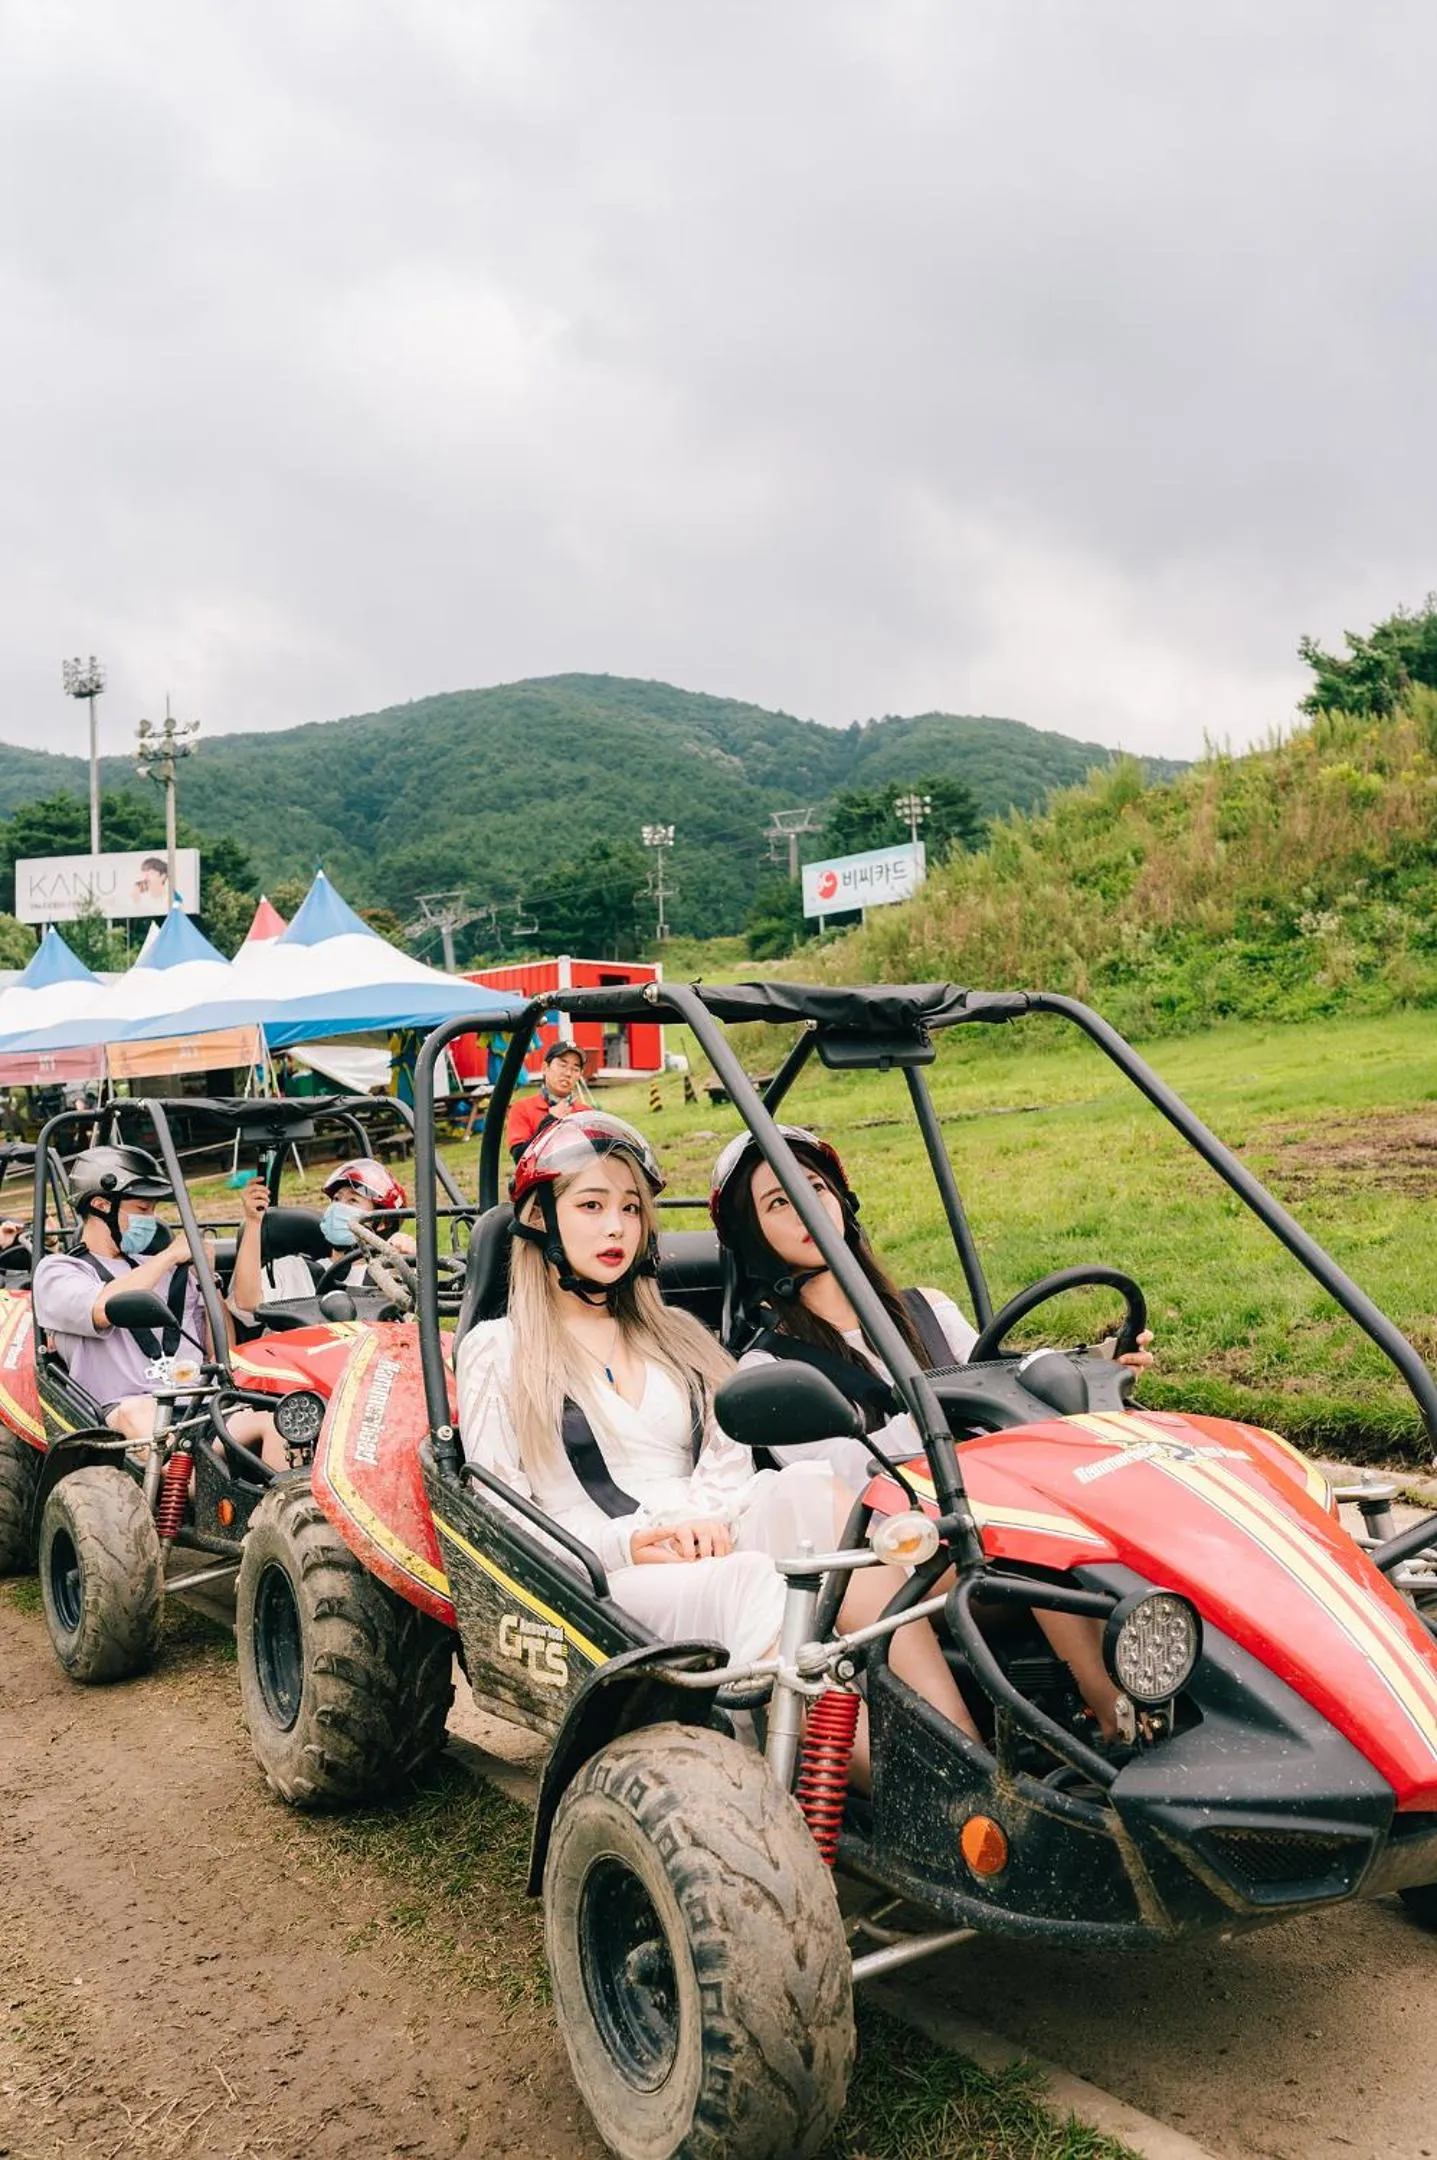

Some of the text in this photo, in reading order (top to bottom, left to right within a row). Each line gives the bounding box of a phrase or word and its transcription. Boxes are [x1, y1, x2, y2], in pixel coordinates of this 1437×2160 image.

[29, 869, 117, 898] KANU
[842, 860, 908, 890] 비씨카드
[499, 1614, 569, 1688] GTS
